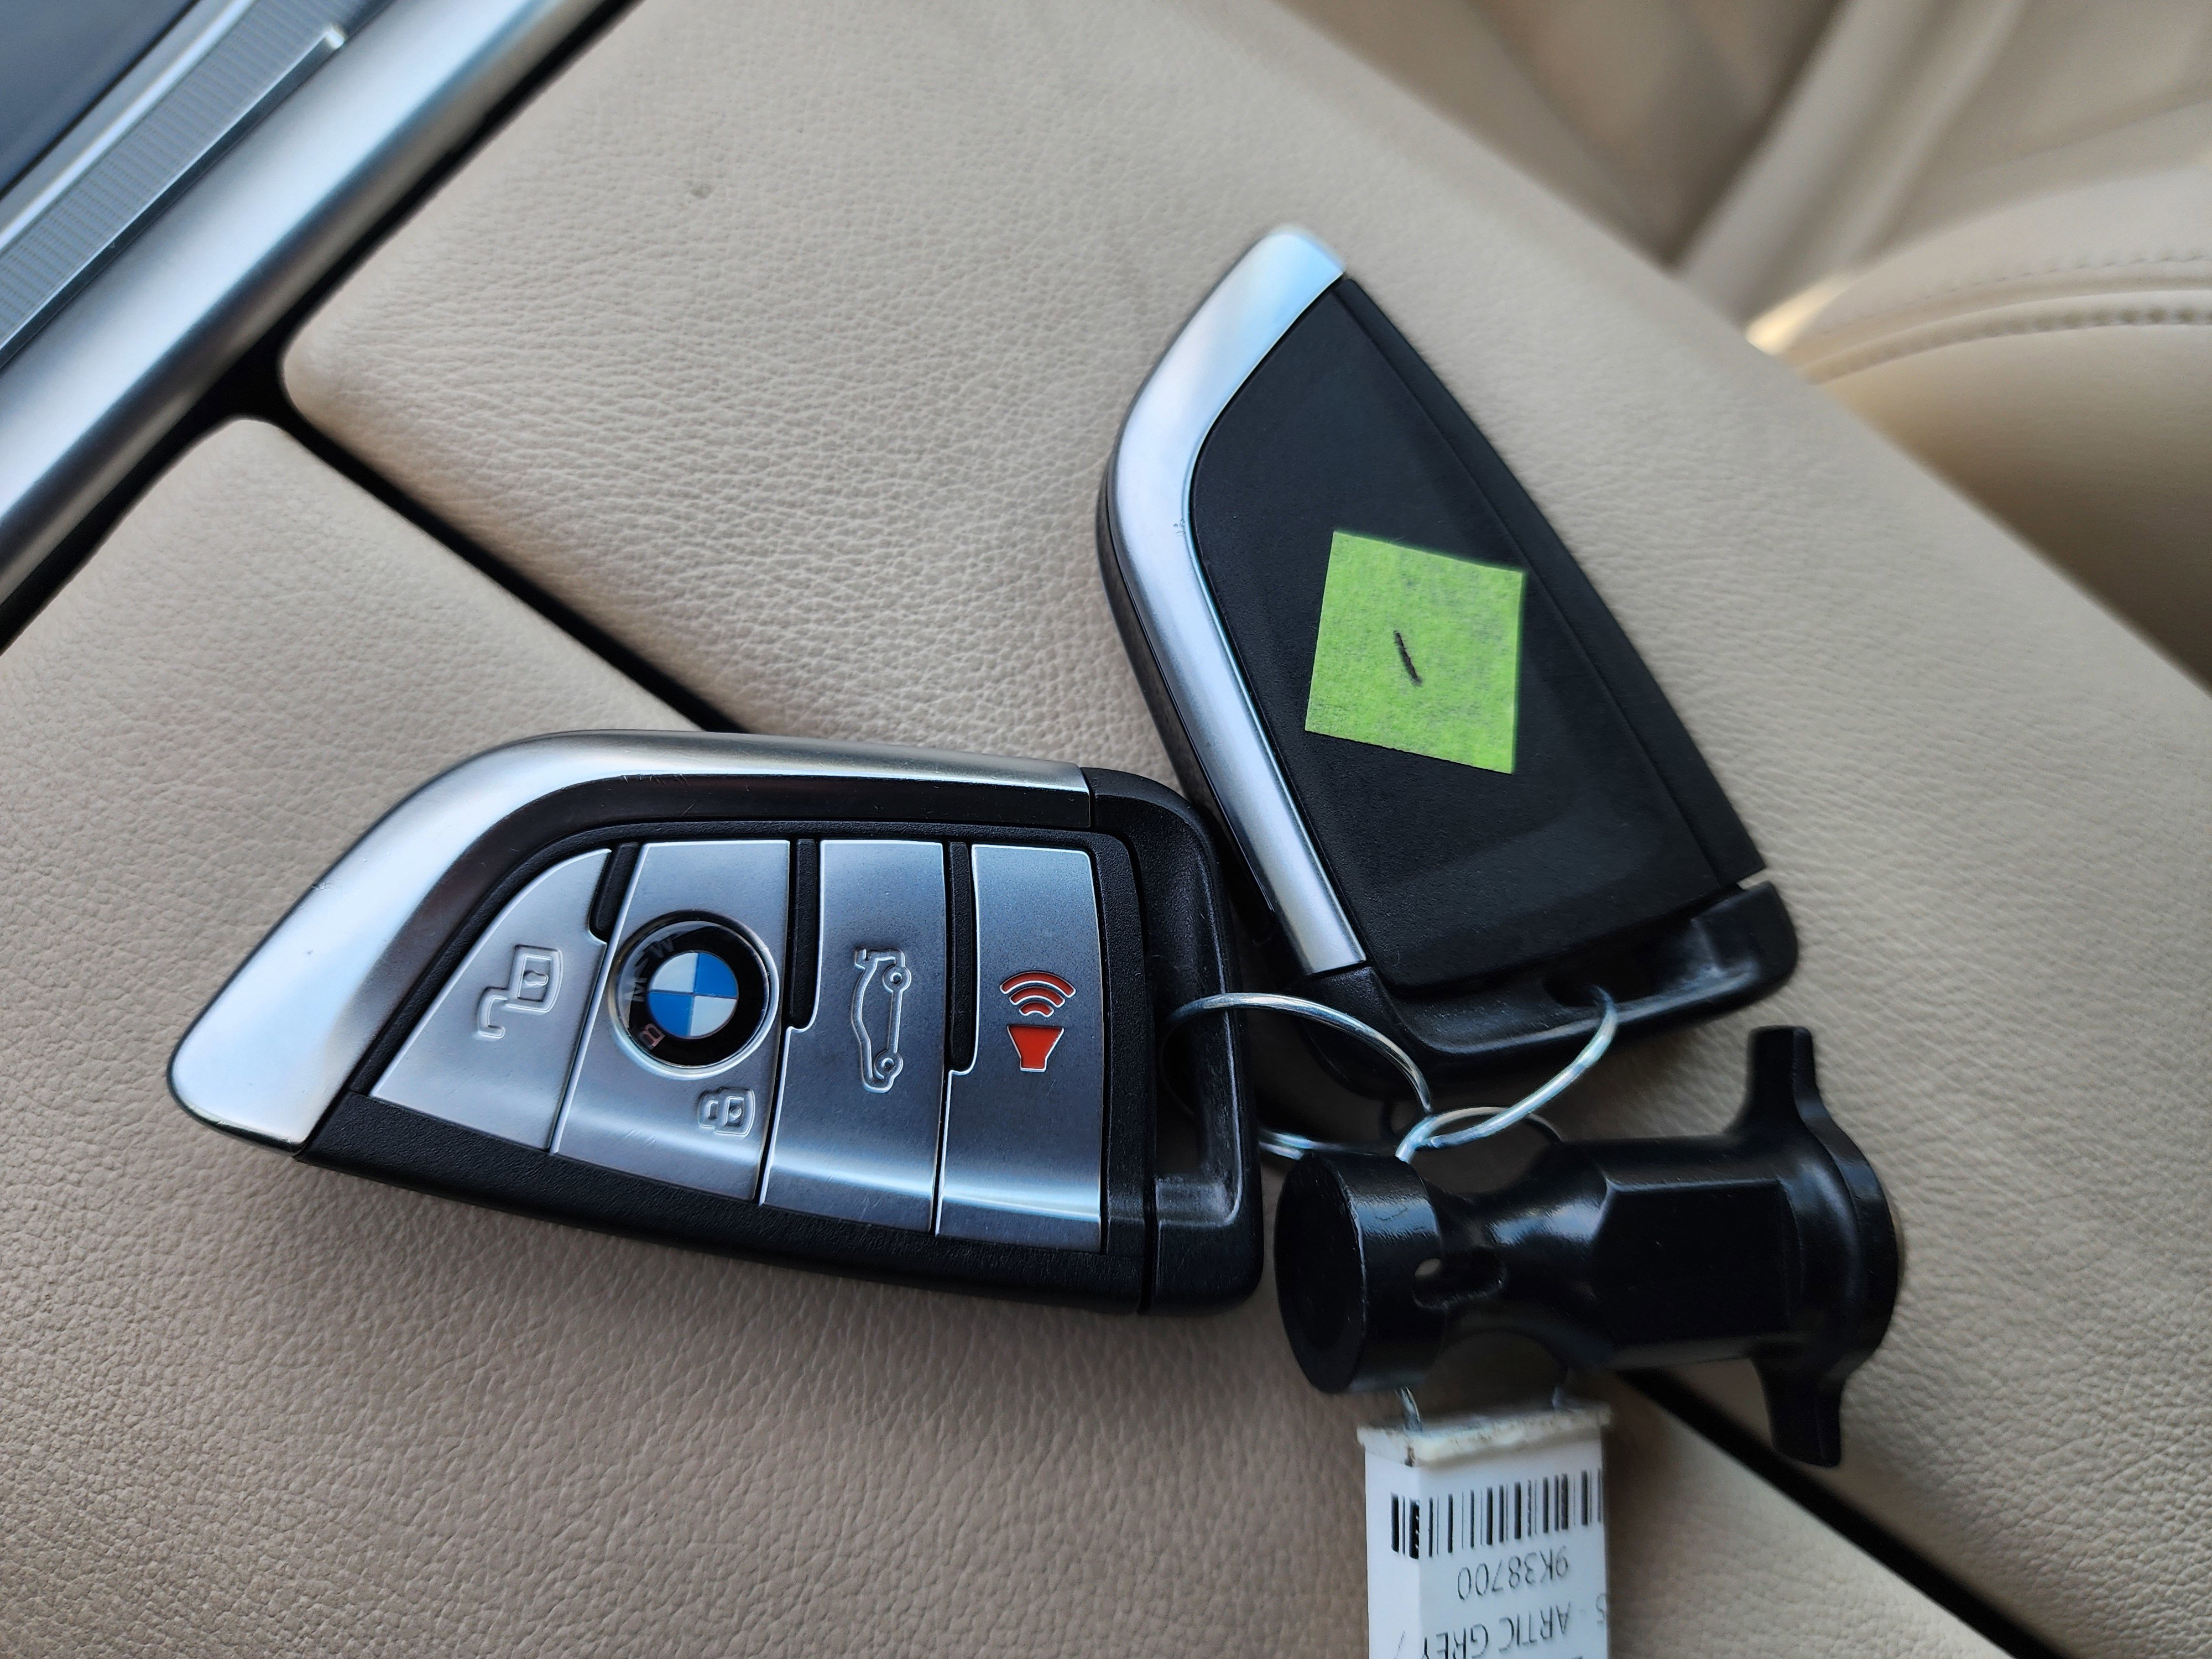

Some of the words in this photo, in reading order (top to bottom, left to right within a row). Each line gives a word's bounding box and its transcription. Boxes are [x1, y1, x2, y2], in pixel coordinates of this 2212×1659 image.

[623, 935, 676, 1051] BMW
[1457, 1546, 1569, 1601] 9K38700
[1421, 1623, 1489, 1659] GREY
[1498, 1601, 1571, 1653] ARTIC
